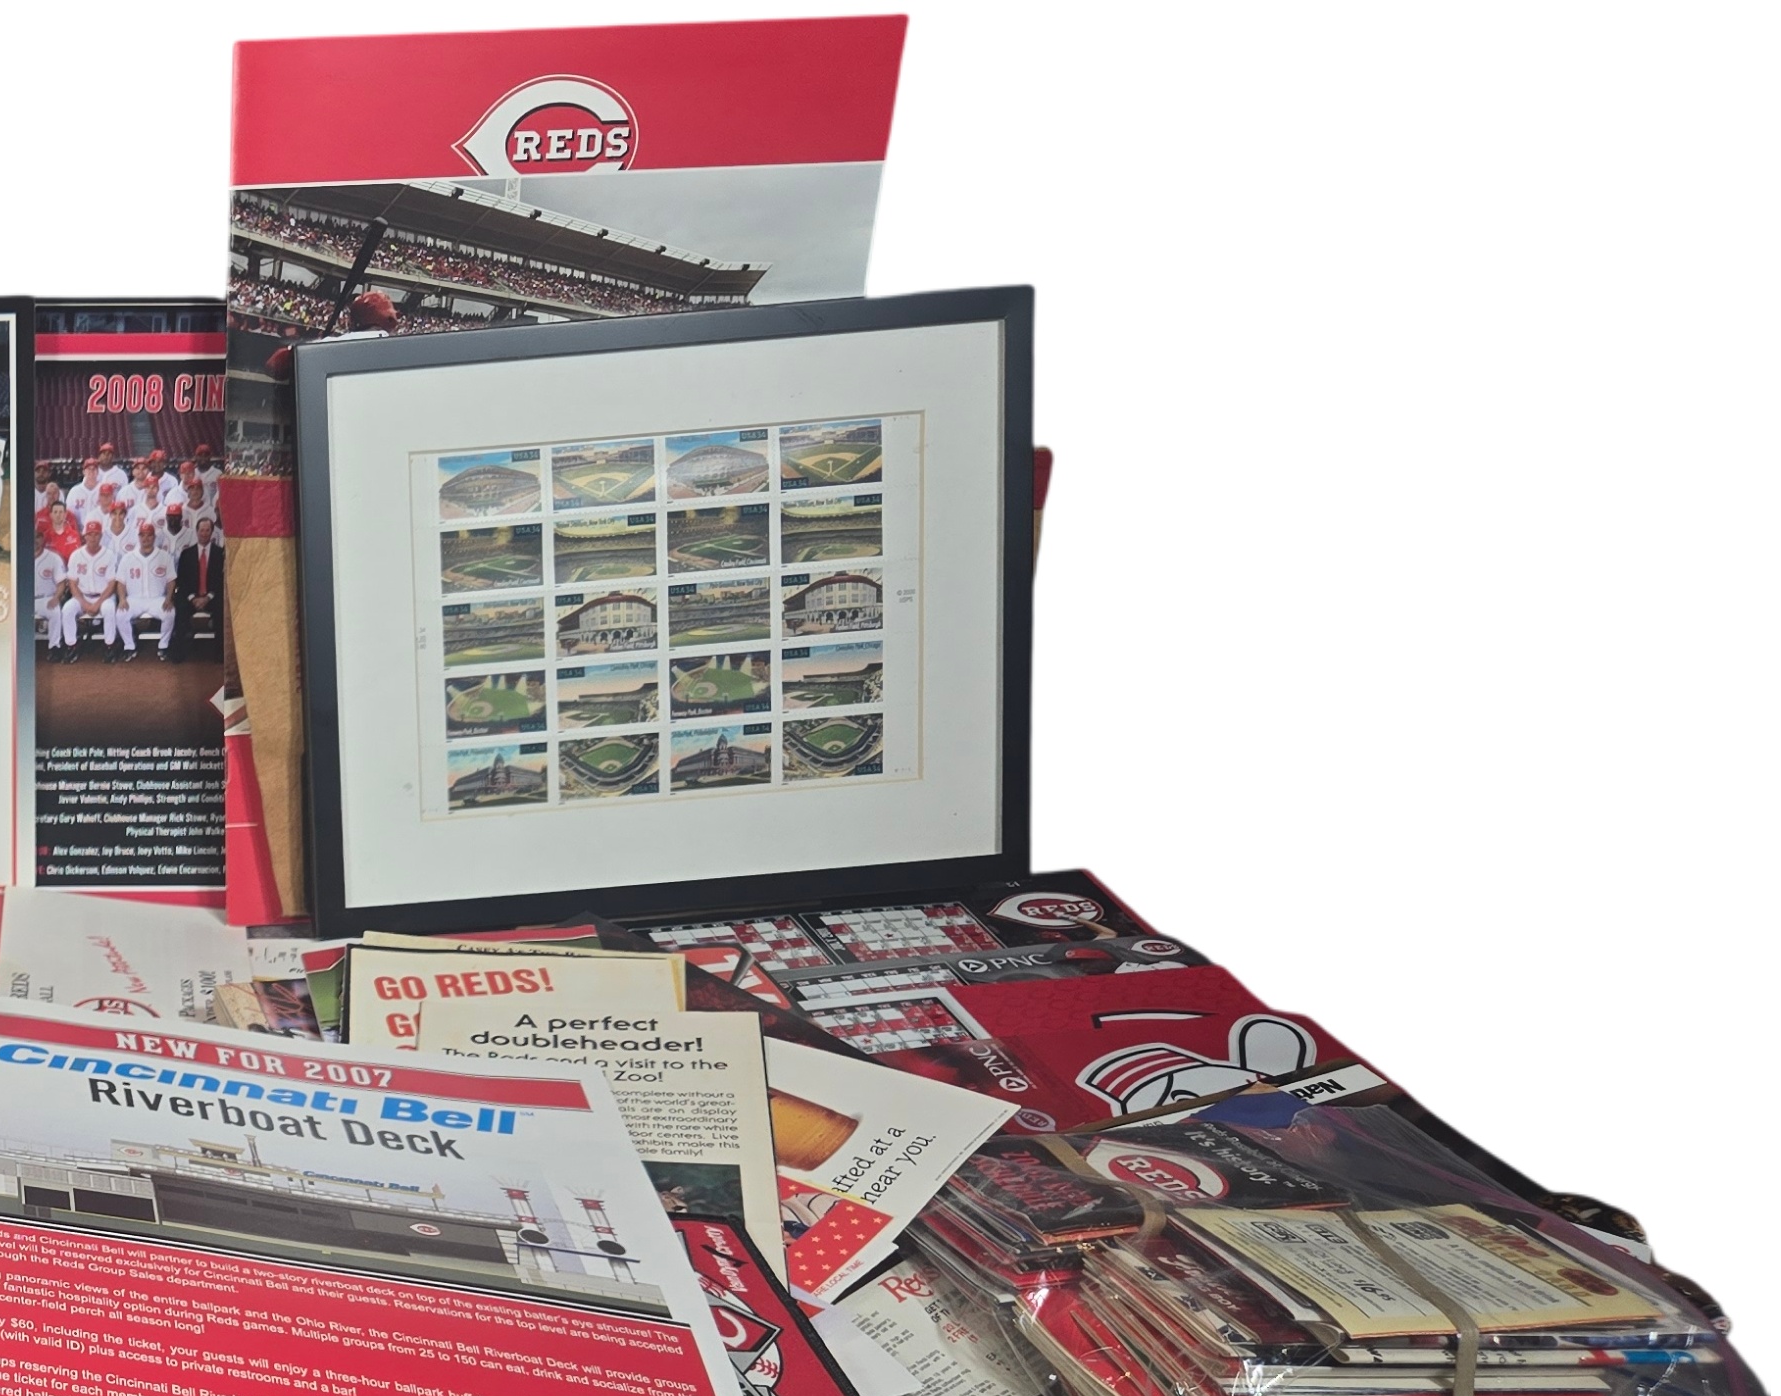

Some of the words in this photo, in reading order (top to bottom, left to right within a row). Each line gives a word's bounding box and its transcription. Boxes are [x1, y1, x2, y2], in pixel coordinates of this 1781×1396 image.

[512, 125, 631, 163] REDS
[87, 374, 163, 414] 2008
[1021, 899, 1097, 917] REDS
[989, 953, 1052, 972] PNC
[374, 975, 427, 1001] GO
[435, 968, 554, 999] REDS!
[515, 1014, 536, 1029] A
[548, 1016, 658, 1034] perfect
[470, 1031, 703, 1053] doubleheader!
[116, 1033, 200, 1060] NEW
[216, 1048, 285, 1076] FOR
[305, 1061, 391, 1088] 2007
[613, 1070, 663, 1084] Zoo!
[968, 1044, 1003, 1080] PNC
[88, 1078, 328, 1140] Riverboat
[344, 1118, 465, 1160] Deck
[380, 1096, 517, 1135] Bell
[657, 1131, 705, 1140] centers.
[712, 1132, 739, 1140] Live
[1184, 1130, 1216, 1148] It's
[1212, 1148, 1278, 1185] history.
